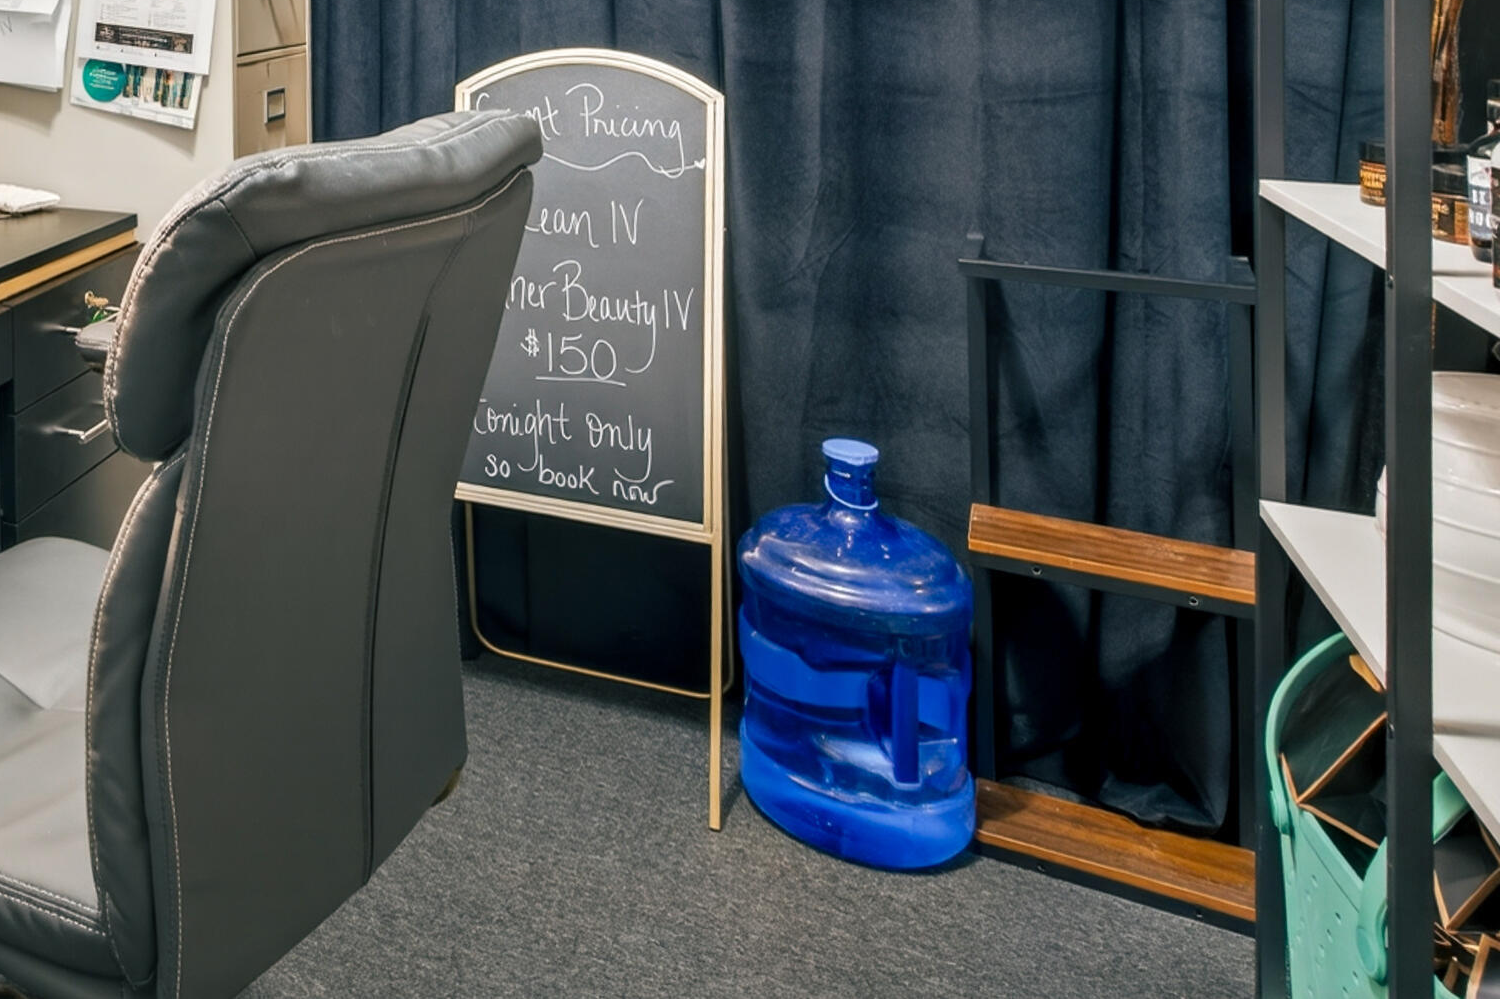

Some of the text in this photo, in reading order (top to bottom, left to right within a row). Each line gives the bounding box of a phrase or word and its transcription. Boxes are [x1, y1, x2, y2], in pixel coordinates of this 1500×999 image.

[565, 83, 685, 179] Pricing
[610, 198, 644, 245] IV
[552, 259, 657, 374] Beauty
[663, 286, 695, 331] IV
[520, 328, 618, 381] $150
[538, 453, 600, 496] book
[612, 479, 675, 505] now
